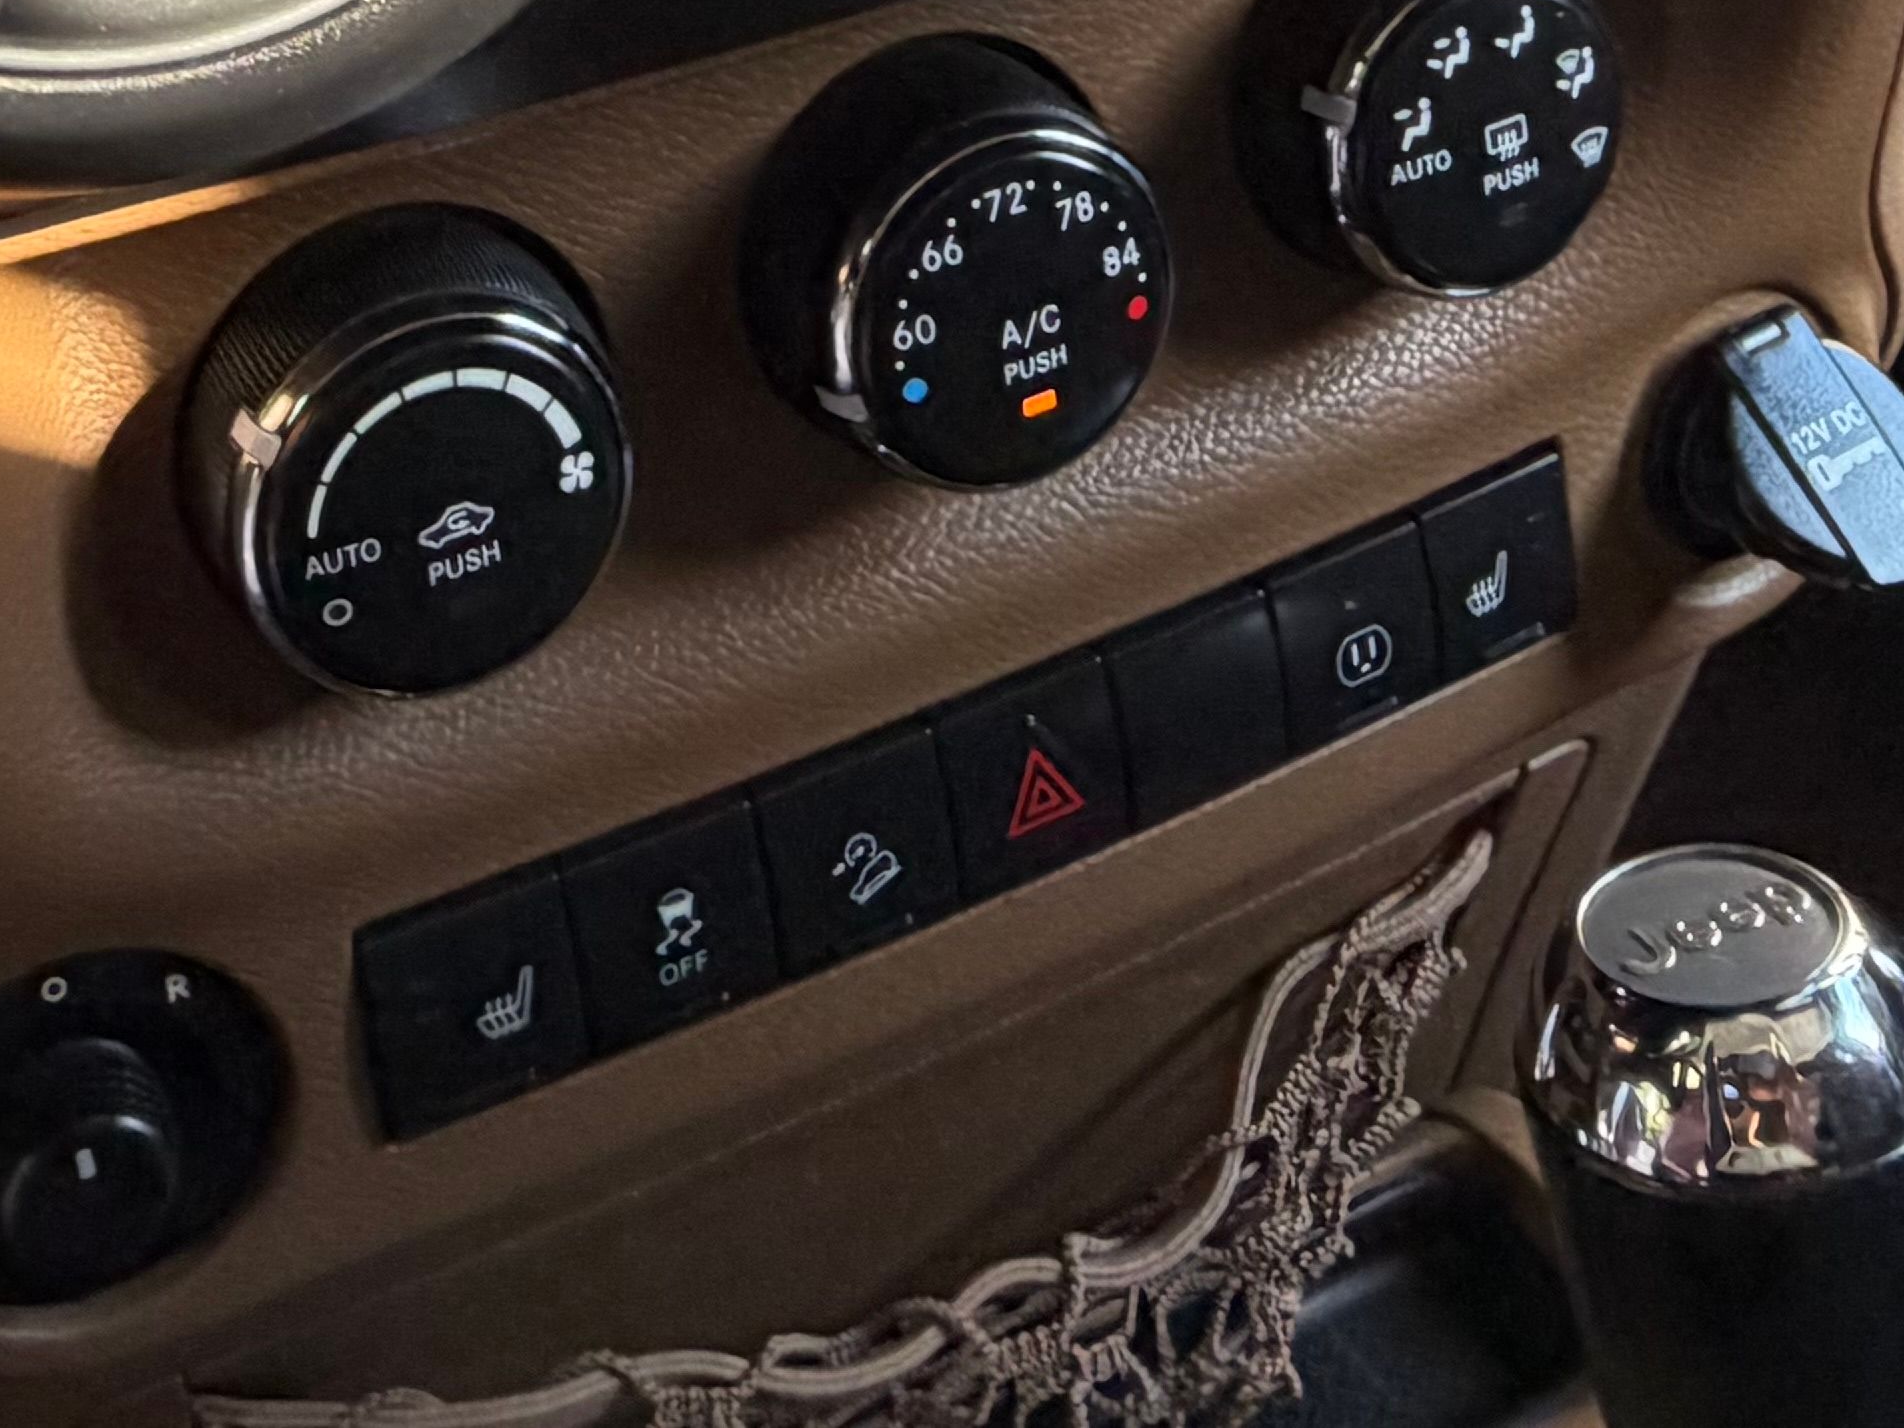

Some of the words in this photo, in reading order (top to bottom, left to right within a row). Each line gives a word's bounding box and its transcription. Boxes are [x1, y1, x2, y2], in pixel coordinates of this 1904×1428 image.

[1390, 149, 1453, 186] AUTO
[1483, 157, 1541, 196] PUSH
[893, 314, 936, 351] 60
[921, 234, 963, 272] 66
[983, 182, 1027, 223] 72
[1055, 191, 1094, 232] 78
[1103, 236, 1141, 277] 84
[1001, 304, 1062, 349] A/C
[1004, 343, 1069, 386] PUSH
[1791, 417, 1832, 455] 12V
[1830, 401, 1867, 435] DC
[305, 537, 382, 582] AUTO
[427, 540, 503, 587] PUSH
[1618, 884, 1813, 978] Jeep
[164, 973, 192, 1004] R
[658, 948, 708, 986] OFF
